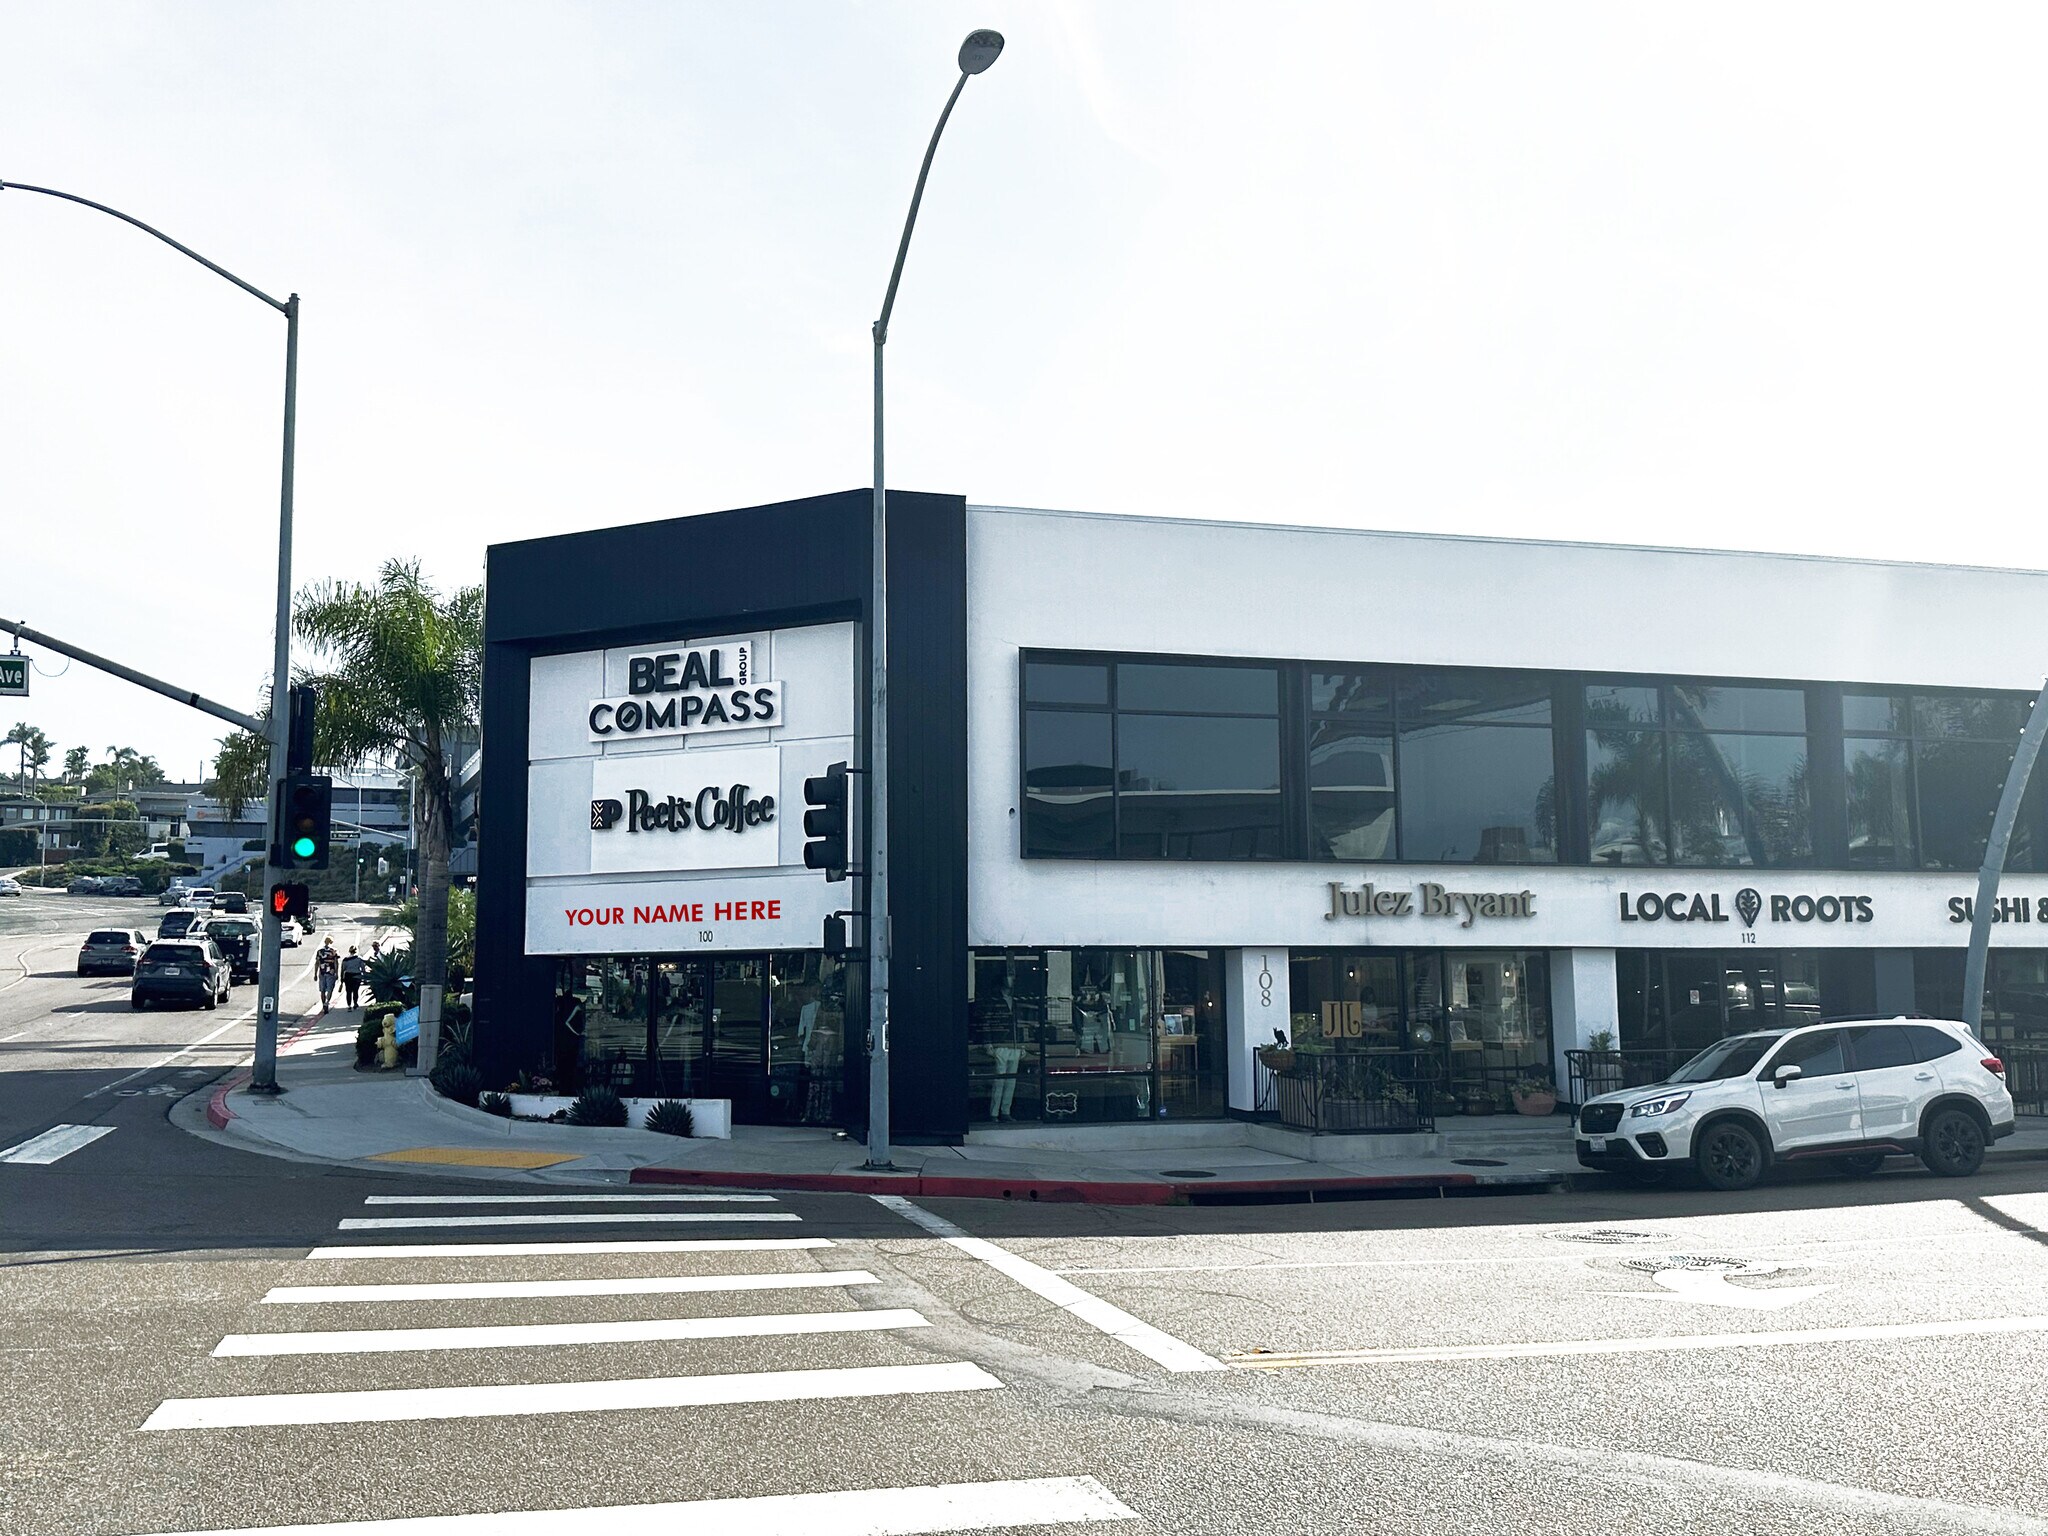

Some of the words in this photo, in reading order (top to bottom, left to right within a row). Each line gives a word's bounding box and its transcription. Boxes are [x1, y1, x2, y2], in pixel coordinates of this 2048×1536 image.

[628, 649, 734, 695] BEAL
[738, 647, 748, 686] GROUP
[589, 688, 774, 735] COMPASS
[625, 789, 692, 833] Peet's
[694, 784, 775, 834] Coffee
[564, 907, 625, 926] YOUR
[633, 904, 704, 924] NAME
[714, 900, 781, 921] HERE
[1325, 881, 1414, 920] Julez
[1419, 882, 1537, 928] Bryant
[1620, 892, 1729, 922] LOCAL
[1770, 895, 1874, 923] ROOTS
[699, 930, 714, 943] 100
[1741, 933, 1756, 944] 112
[1258, 955, 1273, 1007] 108
